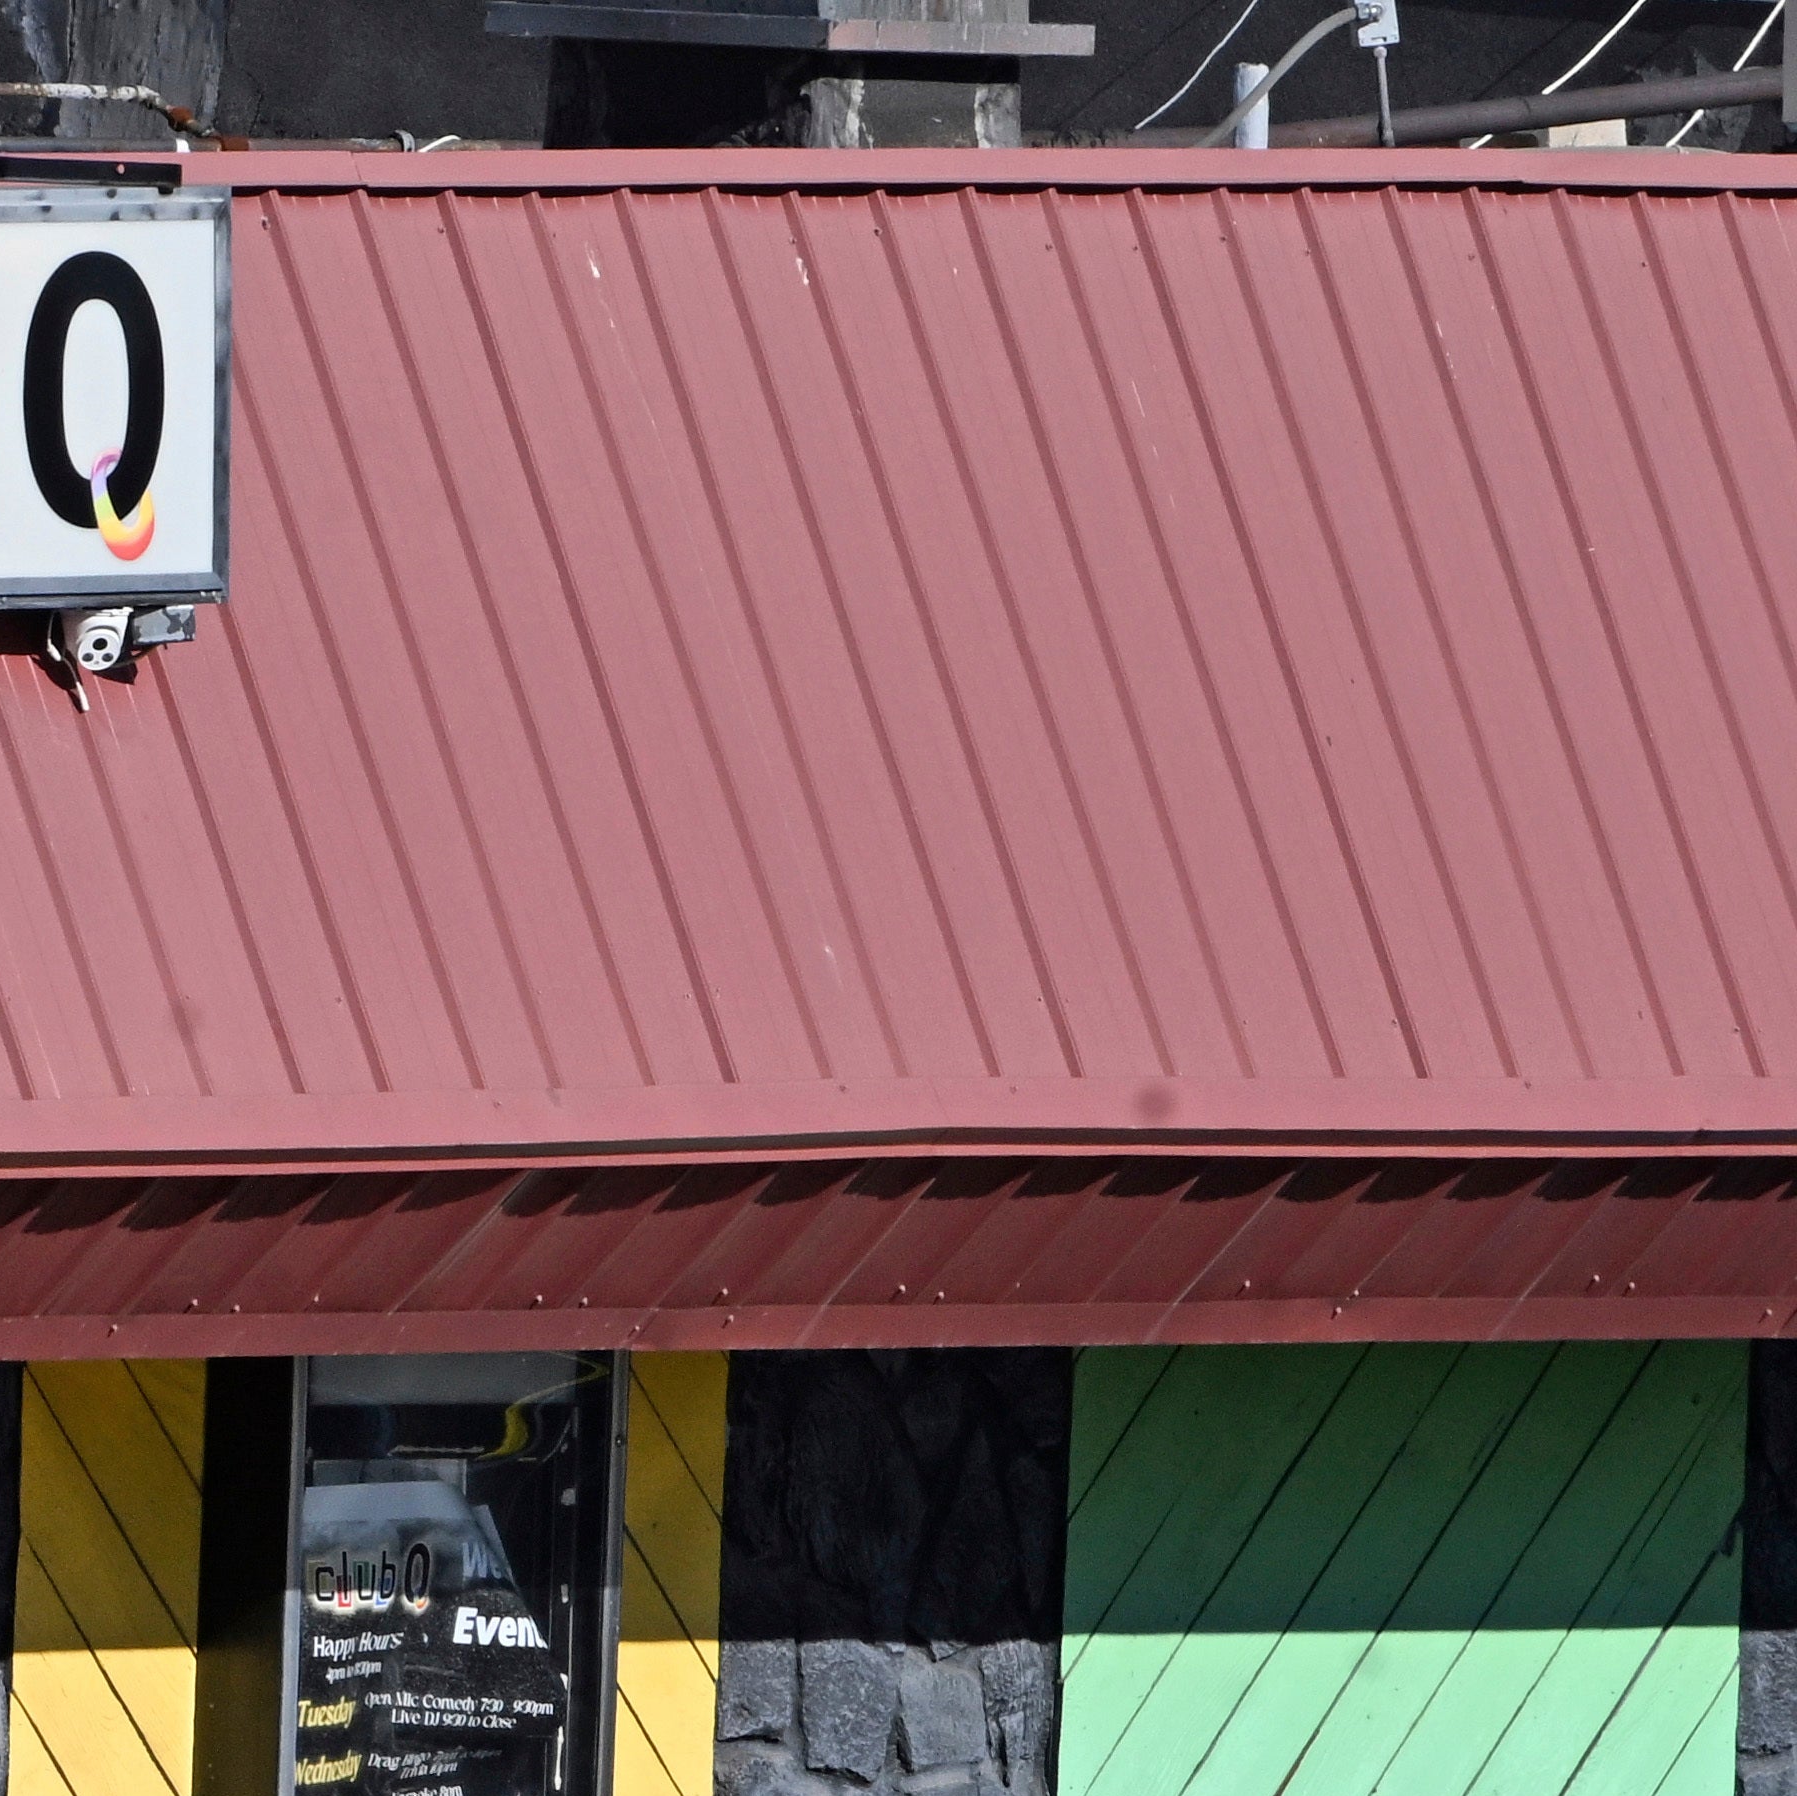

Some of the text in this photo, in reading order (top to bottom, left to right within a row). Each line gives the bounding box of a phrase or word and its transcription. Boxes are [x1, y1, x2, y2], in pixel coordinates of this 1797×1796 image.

[23, 250, 166, 561] Q
[315, 1543, 431, 1609] club Q
[313, 1631, 404, 1662] Happy Hours
[298, 1696, 357, 1728] Tuesday
[391, 1709, 421, 1725] Live
[424, 1711, 441, 1727] DJ
[468, 1714, 481, 1728] to
[482, 1714, 517, 1729] Close
[422, 1694, 477, 1715] Comedy
[295, 1749, 363, 1786] Wednesday
[368, 1753, 401, 1771] Drag
